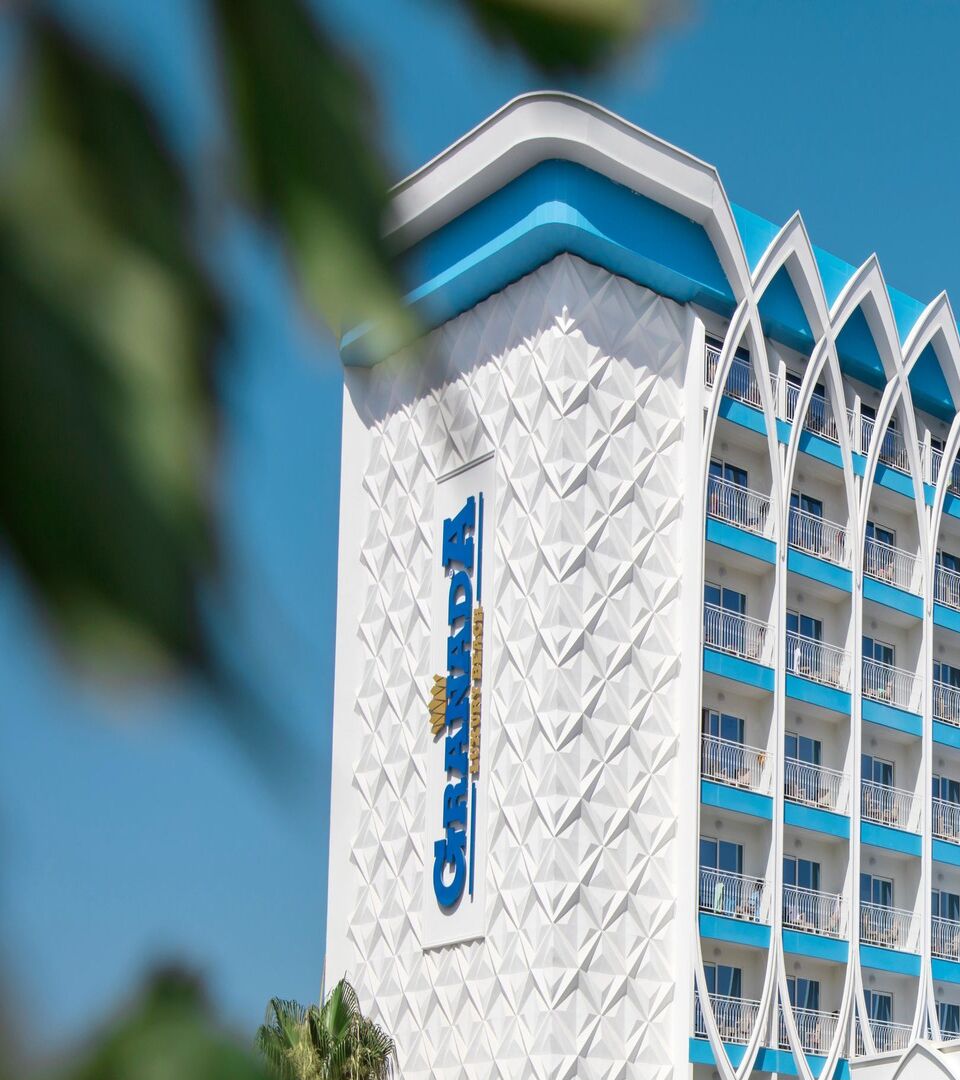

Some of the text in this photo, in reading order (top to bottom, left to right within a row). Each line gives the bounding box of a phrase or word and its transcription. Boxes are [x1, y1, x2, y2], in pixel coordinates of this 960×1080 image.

[433, 496, 475, 906] GRANADA
[470, 608, 483, 774] LUXURY BEACH
